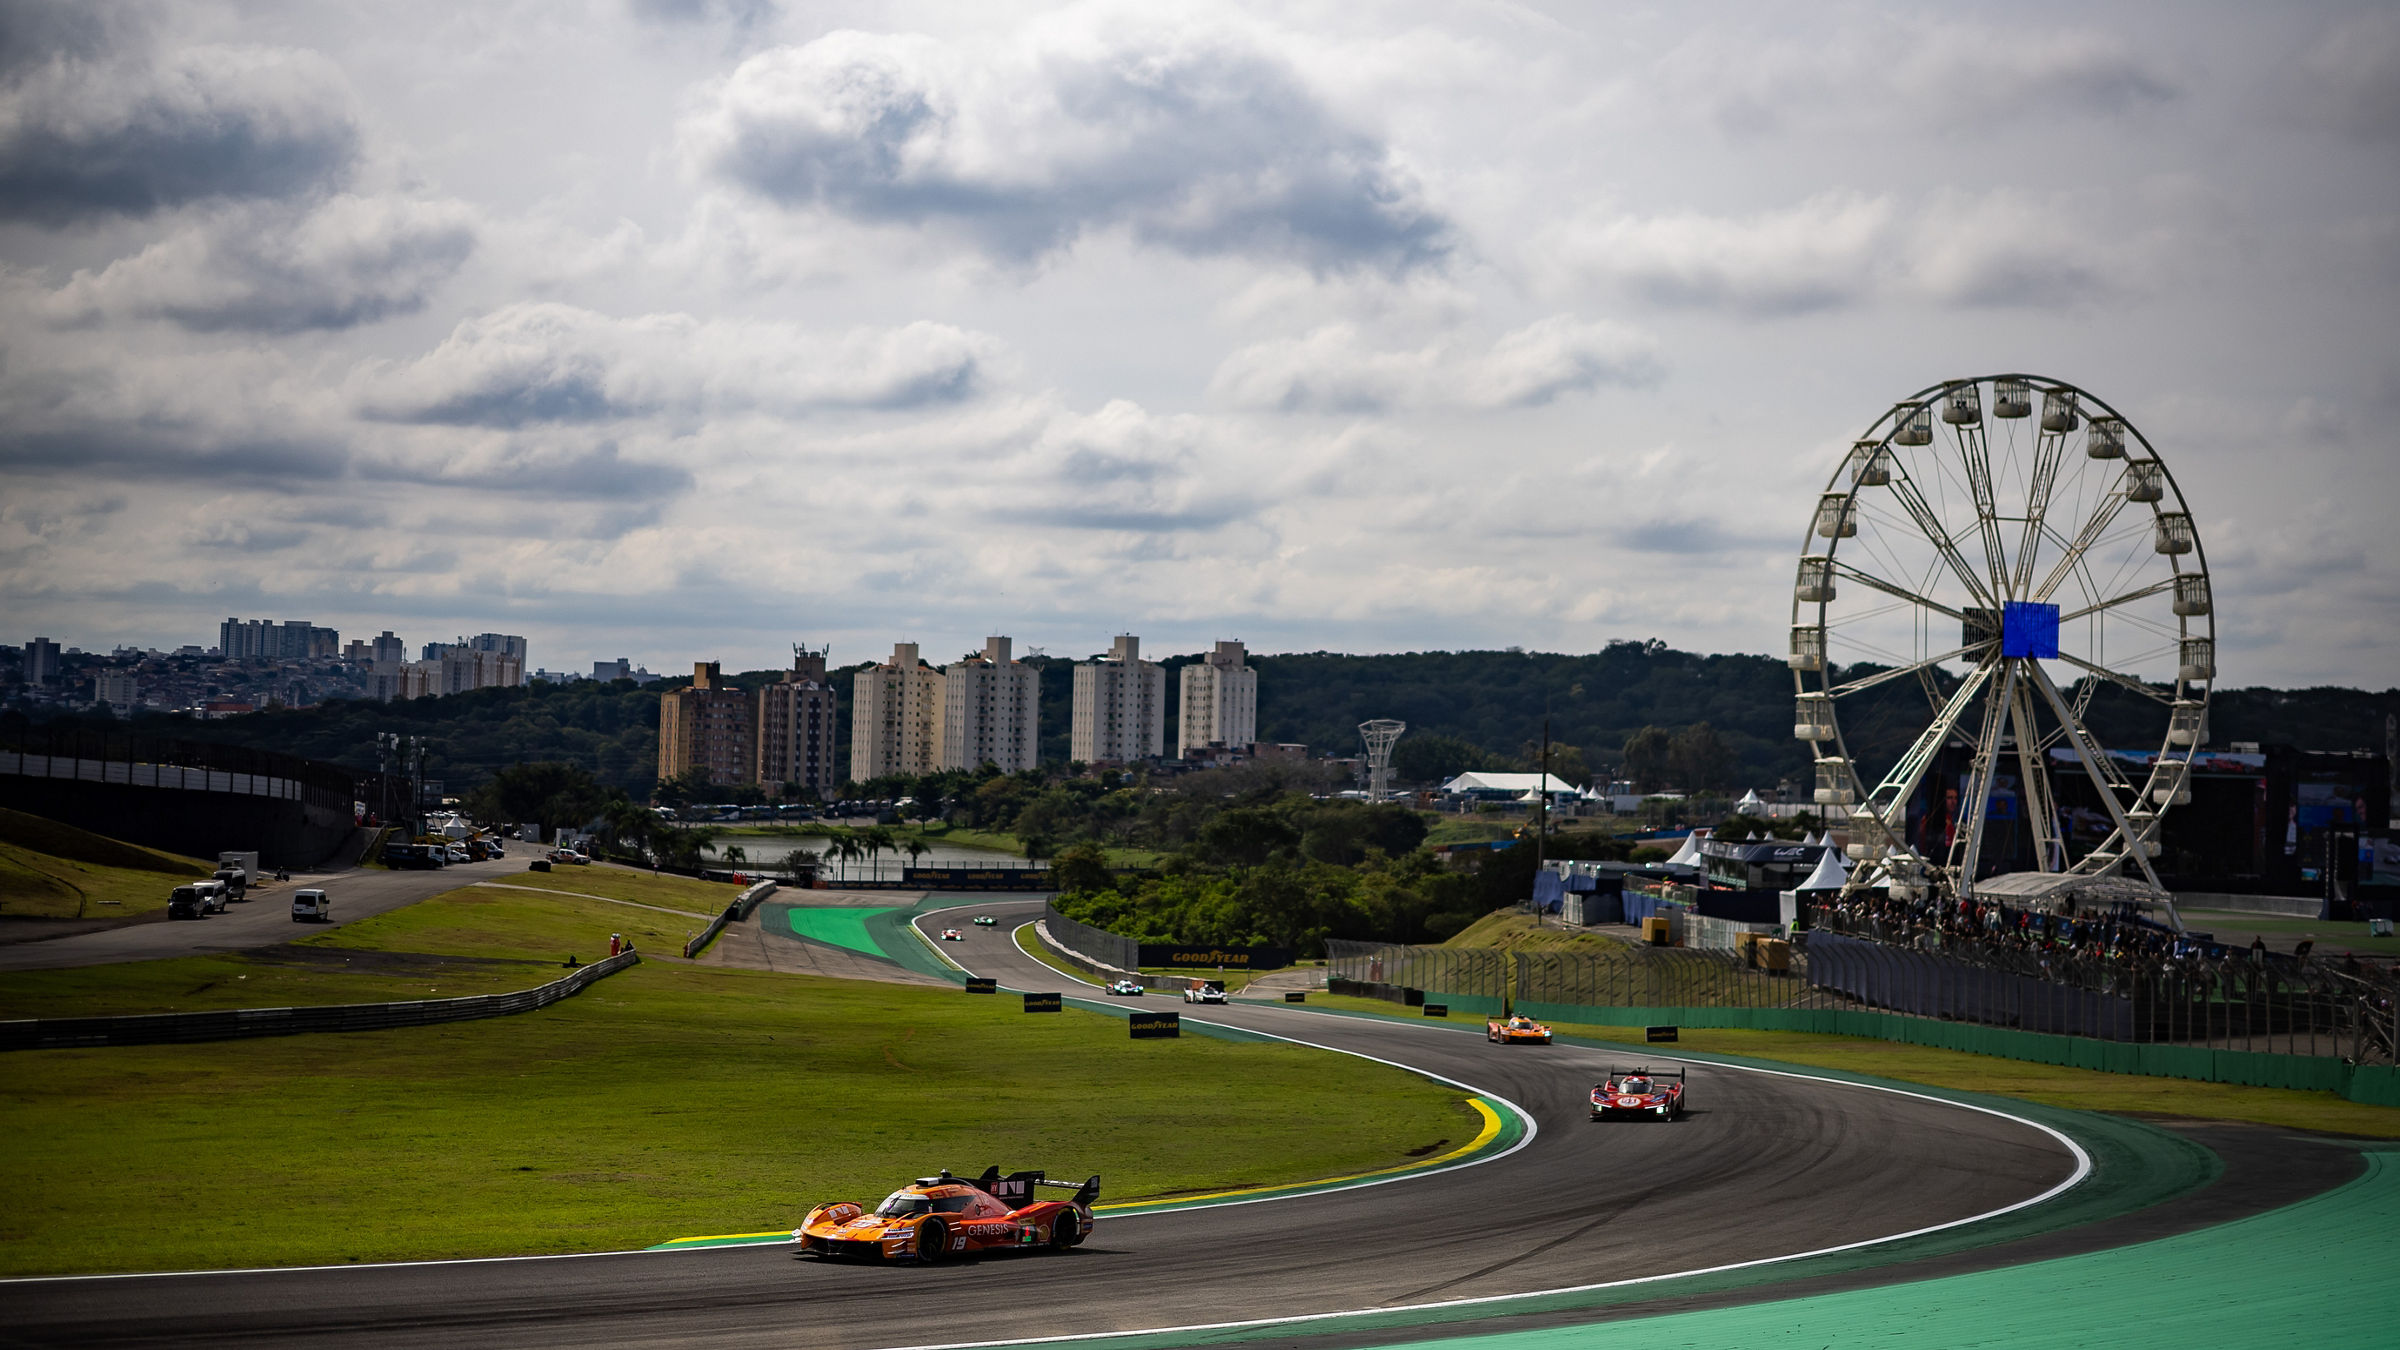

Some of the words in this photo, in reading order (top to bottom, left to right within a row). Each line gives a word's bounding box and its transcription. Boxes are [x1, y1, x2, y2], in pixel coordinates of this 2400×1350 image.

[1172, 949, 1249, 964] GOODYEAR
[1025, 998, 1060, 1007] GOODYEAR
[1131, 1020, 1178, 1030] GOODYEAR
[967, 1223, 1009, 1236] GENESIS
[952, 1236, 967, 1250] 19
